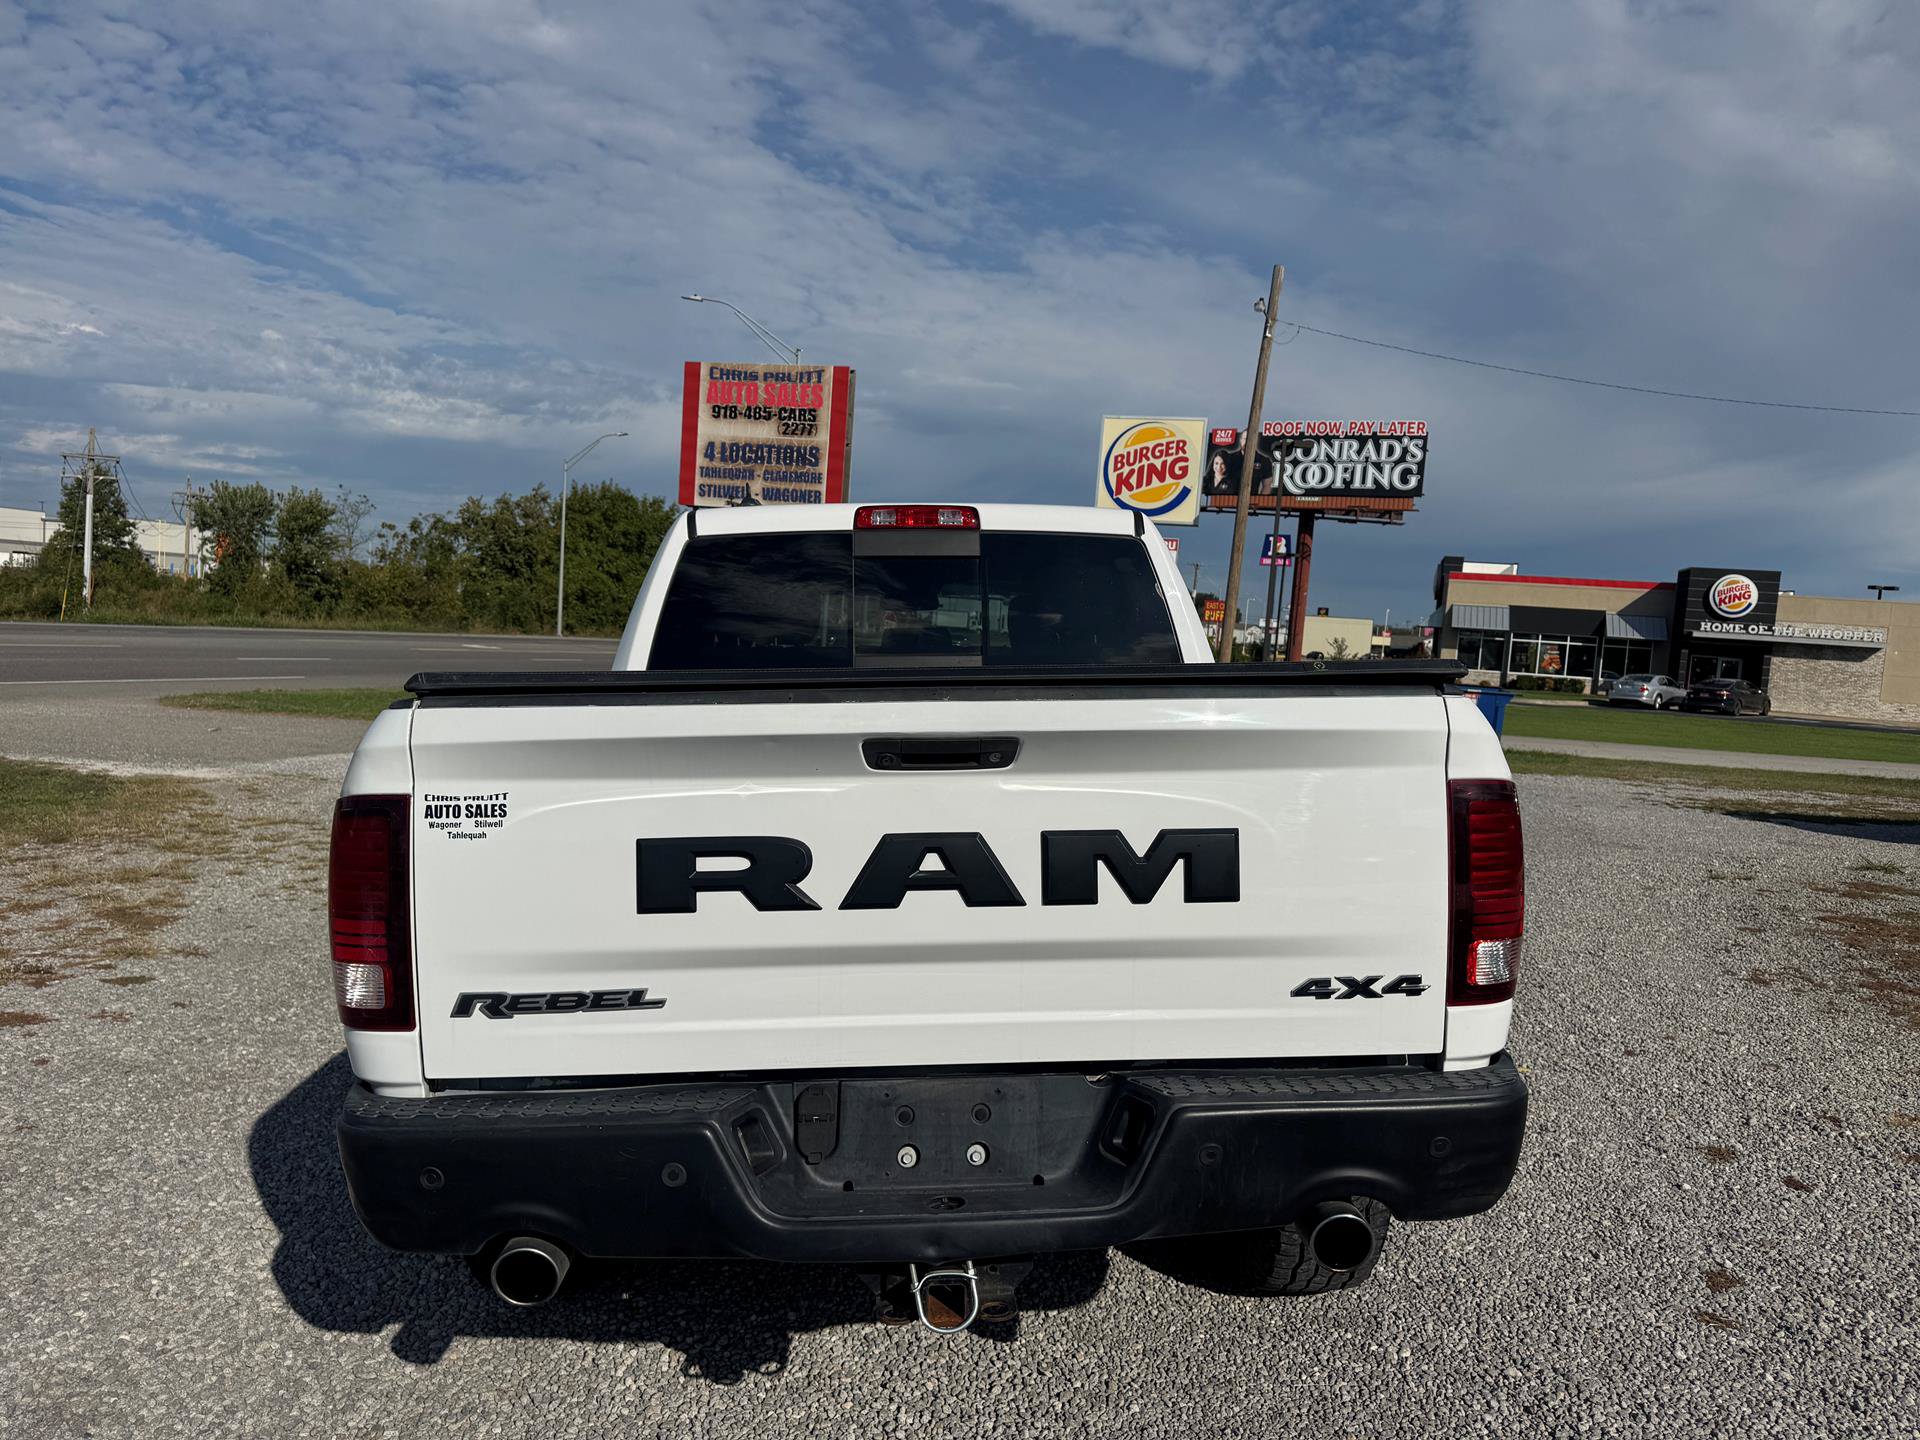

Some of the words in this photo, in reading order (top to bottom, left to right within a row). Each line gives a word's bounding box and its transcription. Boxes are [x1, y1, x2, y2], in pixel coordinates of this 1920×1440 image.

[709, 367, 758, 382] CHRIS
[763, 369, 825, 384] PRUITT
[706, 382, 760, 406] AUTO
[764, 383, 824, 409] SALES
[712, 405, 817, 422] 918-485-CARS
[777, 423, 818, 437] (2277)
[1216, 430, 1233, 438] 24/7
[1263, 421, 1303, 436] ROOF
[1305, 420, 1345, 437] NOW,
[1348, 420, 1375, 436] PAY
[1378, 420, 1427, 436] LATER
[704, 442, 716, 462] 4
[720, 442, 820, 467] LOCATIONS
[1113, 439, 1188, 473] BURGER
[699, 466, 755, 481] TAHLEQUAH
[763, 471, 823, 484] CLAREMORE
[1114, 456, 1190, 497] KING
[1270, 461, 1421, 495] ROOFING
[698, 484, 749, 499] STILWEL
[762, 487, 822, 503] WAGONER
[1717, 584, 1751, 597] BURGER
[1718, 590, 1752, 608] KING
[1205, 610, 1224, 621] BUFF
[1700, 621, 1746, 634] HOME
[1749, 625, 1773, 635] OF
[1772, 626, 1807, 638] THE
[1808, 627, 1884, 642] WHOPPER
[424, 794, 461, 802] CHRIS
[463, 792, 509, 801] PRUITT
[424, 804, 461, 819] AUTO
[465, 803, 507, 819] SALES
[428, 821, 462, 830] Wagoner
[474, 820, 503, 828] Stilwell
[447, 831, 487, 840] Tahlequah
[637, 827, 1241, 914] RAM
[450, 988, 667, 1019] REBEL
